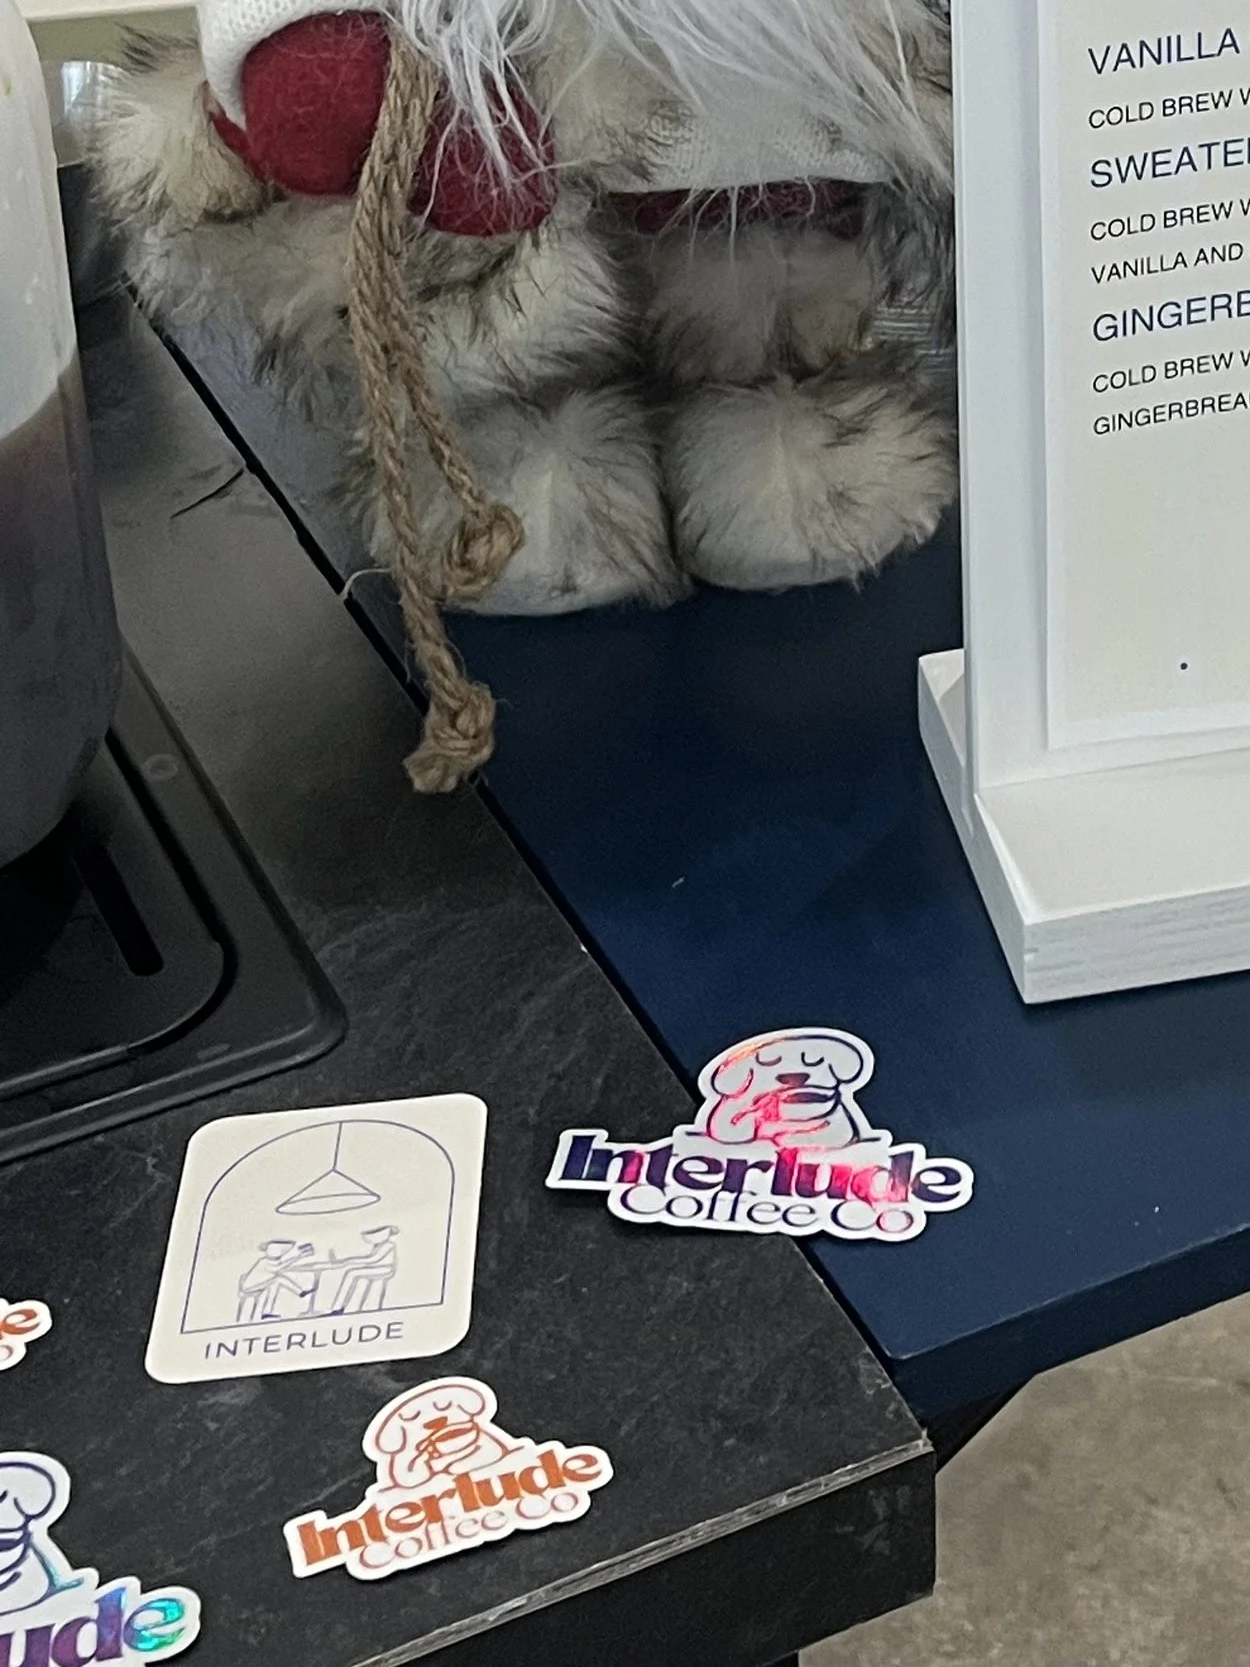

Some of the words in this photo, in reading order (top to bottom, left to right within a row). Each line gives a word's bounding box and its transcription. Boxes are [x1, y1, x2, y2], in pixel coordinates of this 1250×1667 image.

[1087, 27, 1241, 76] VANILLA
[1088, 101, 1155, 130] COLD
[1161, 88, 1234, 118] BREW
[1089, 213, 1156, 242] COLD
[1162, 200, 1234, 230] BREW
[1090, 251, 1189, 285] VANILLA
[1193, 242, 1244, 267] AND
[1092, 364, 1157, 394] COLD
[1163, 350, 1234, 380] BREW
[558, 1134, 962, 1203] Interlude
[620, 1184, 819, 1226] Coffee
[830, 1199, 914, 1233] Co
[203, 1318, 405, 1362] INTERLUDE
[296, 1449, 603, 1566] Interlude
[359, 1516, 508, 1569] Coffee
[515, 1492, 579, 1519] Co
